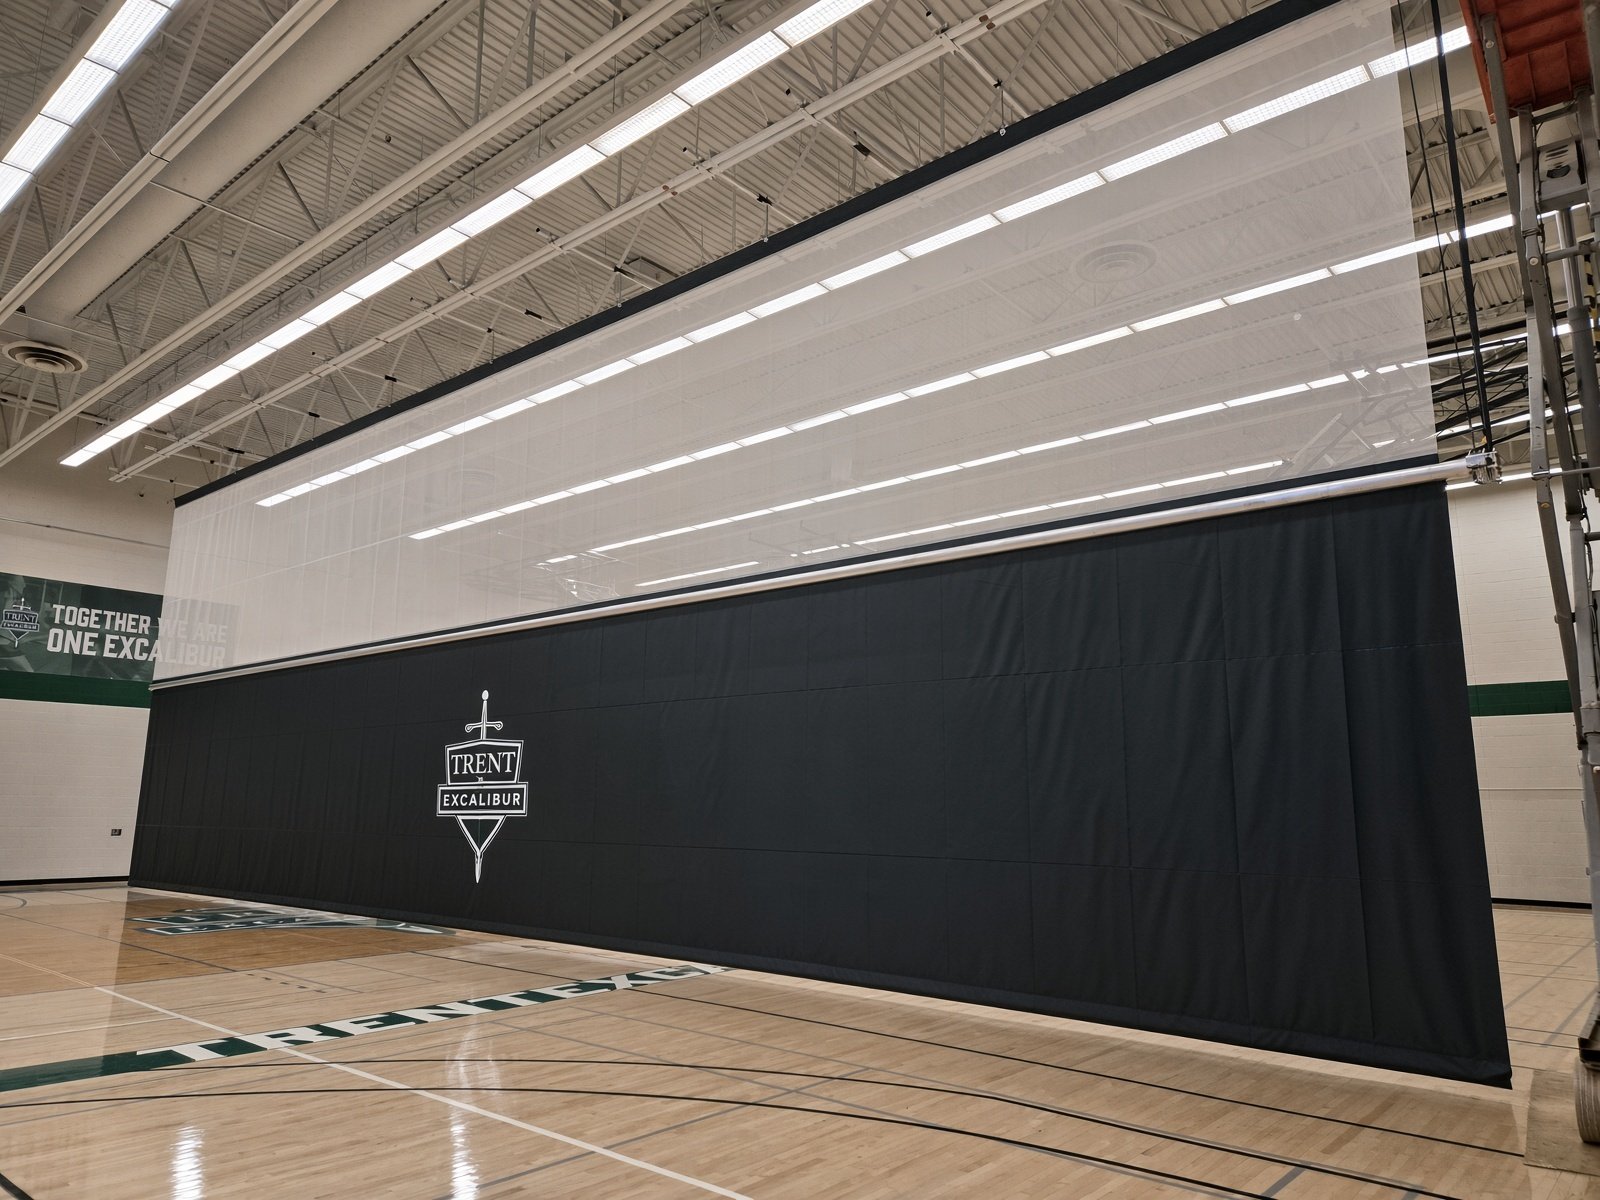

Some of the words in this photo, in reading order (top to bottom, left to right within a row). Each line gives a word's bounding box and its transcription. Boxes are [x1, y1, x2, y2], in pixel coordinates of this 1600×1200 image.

[53, 604, 151, 635] TOGETHER
[157, 617, 188, 638] WE
[193, 622, 228, 643] ARE
[47, 628, 98, 656] ONE
[103, 634, 226, 667] EXCALIBUR
[451, 752, 516, 775] TRENT
[443, 793, 521, 807] EXCALIBUR
